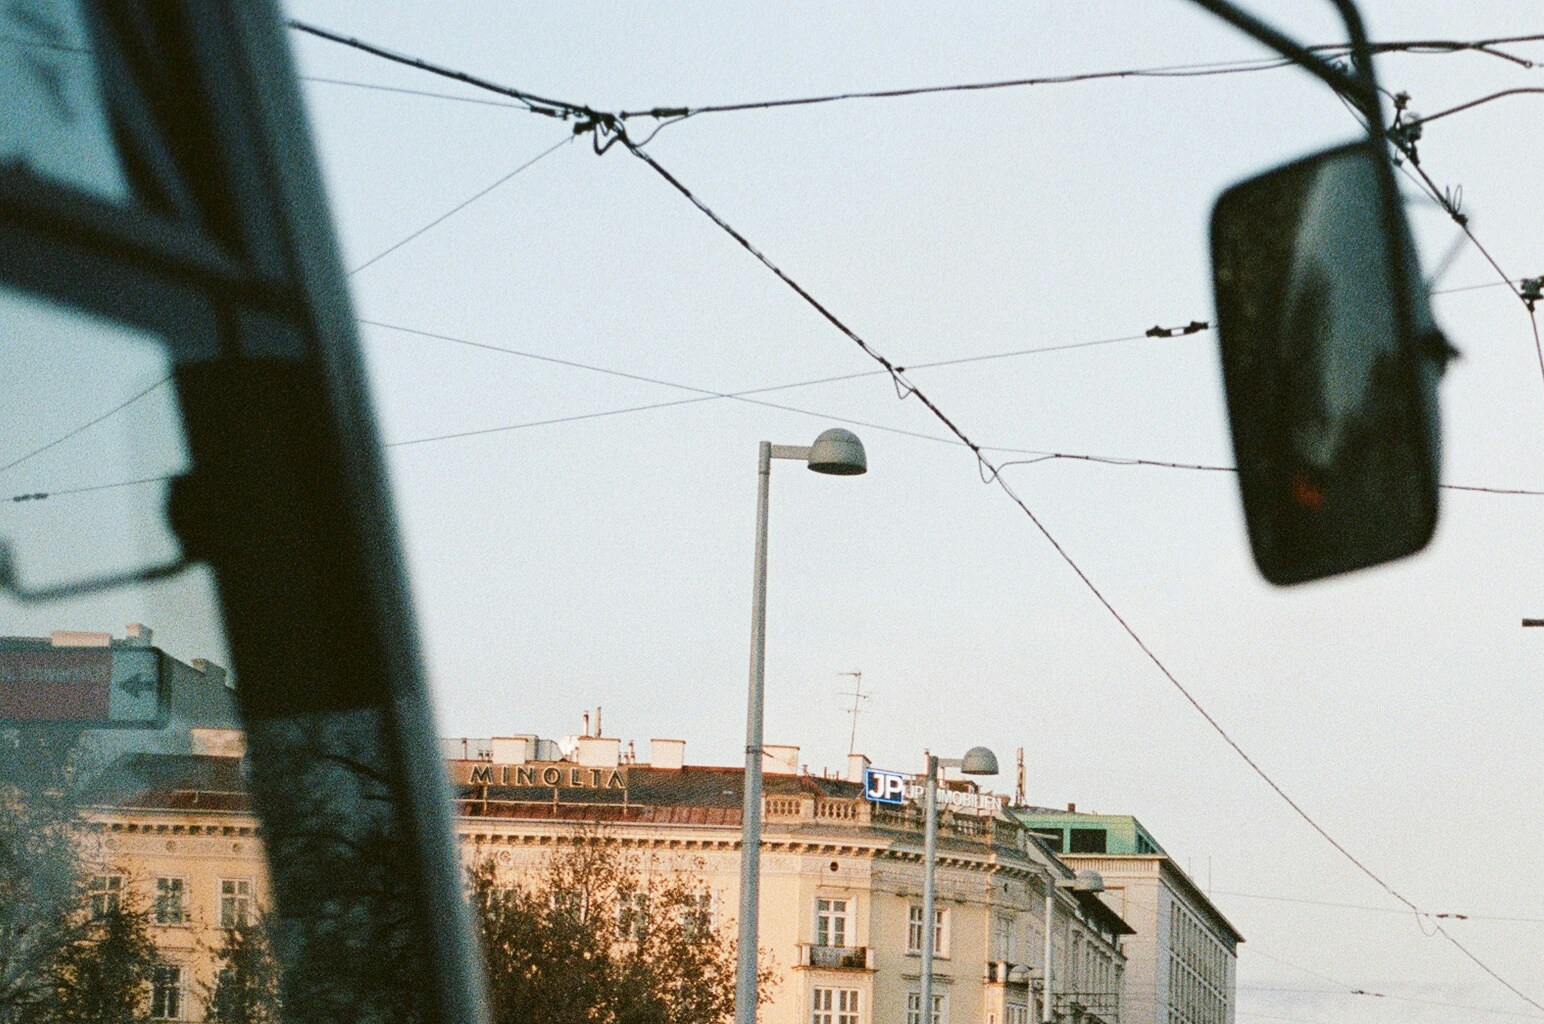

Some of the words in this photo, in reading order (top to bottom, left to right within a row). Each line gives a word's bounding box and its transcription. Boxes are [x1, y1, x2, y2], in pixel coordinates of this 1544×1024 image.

[468, 763, 627, 789] MINOLTA
[868, 773, 903, 799] JP
[909, 785, 925, 800] JP
